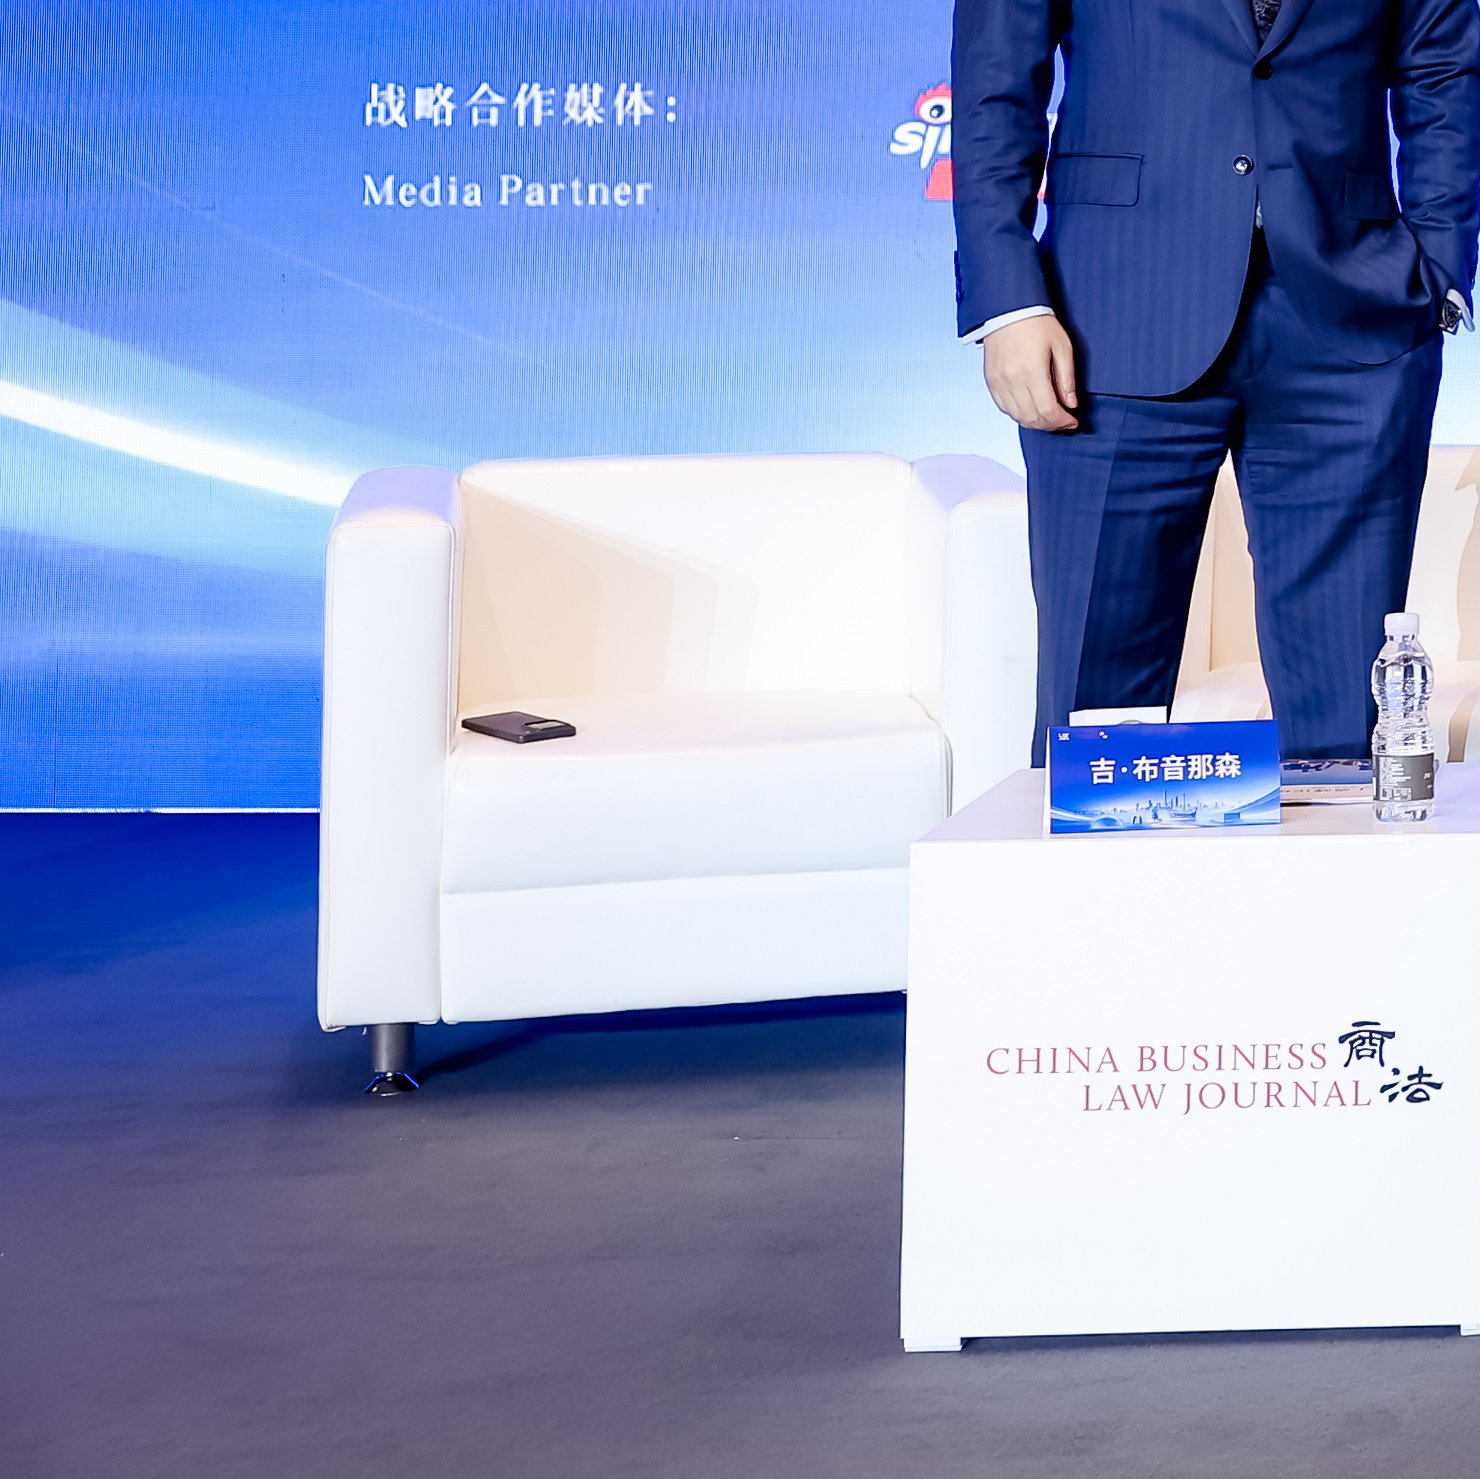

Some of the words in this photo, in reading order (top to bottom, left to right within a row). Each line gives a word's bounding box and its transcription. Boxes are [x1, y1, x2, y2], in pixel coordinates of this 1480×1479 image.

[364, 175, 481, 207] Media
[500, 175, 652, 206] Partner
[1090, 752, 1245, 788] 吉·布音那森
[987, 1047, 1119, 1074] CHINA
[1138, 1043, 1326, 1071] BUSINESS
[1084, 1084, 1166, 1111] LAW
[1184, 1080, 1371, 1115] JOURNAL
